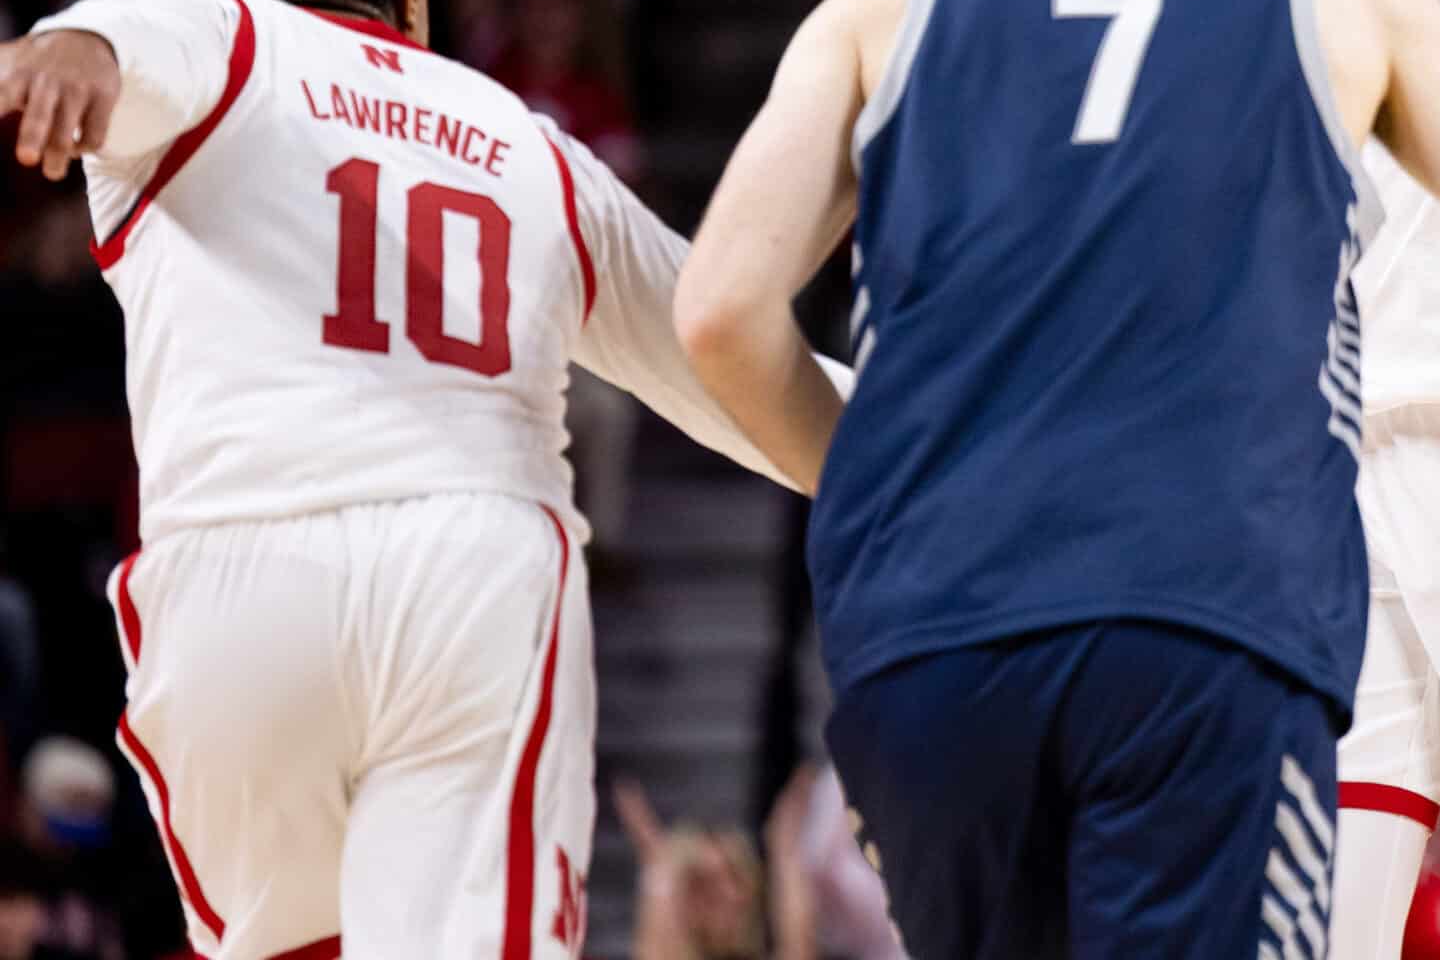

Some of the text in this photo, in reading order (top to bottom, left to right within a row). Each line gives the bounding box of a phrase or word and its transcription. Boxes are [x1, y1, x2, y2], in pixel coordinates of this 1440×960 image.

[361, 44, 404, 76] N
[301, 79, 511, 177] LAWRENCE
[322, 157, 512, 378] 10
